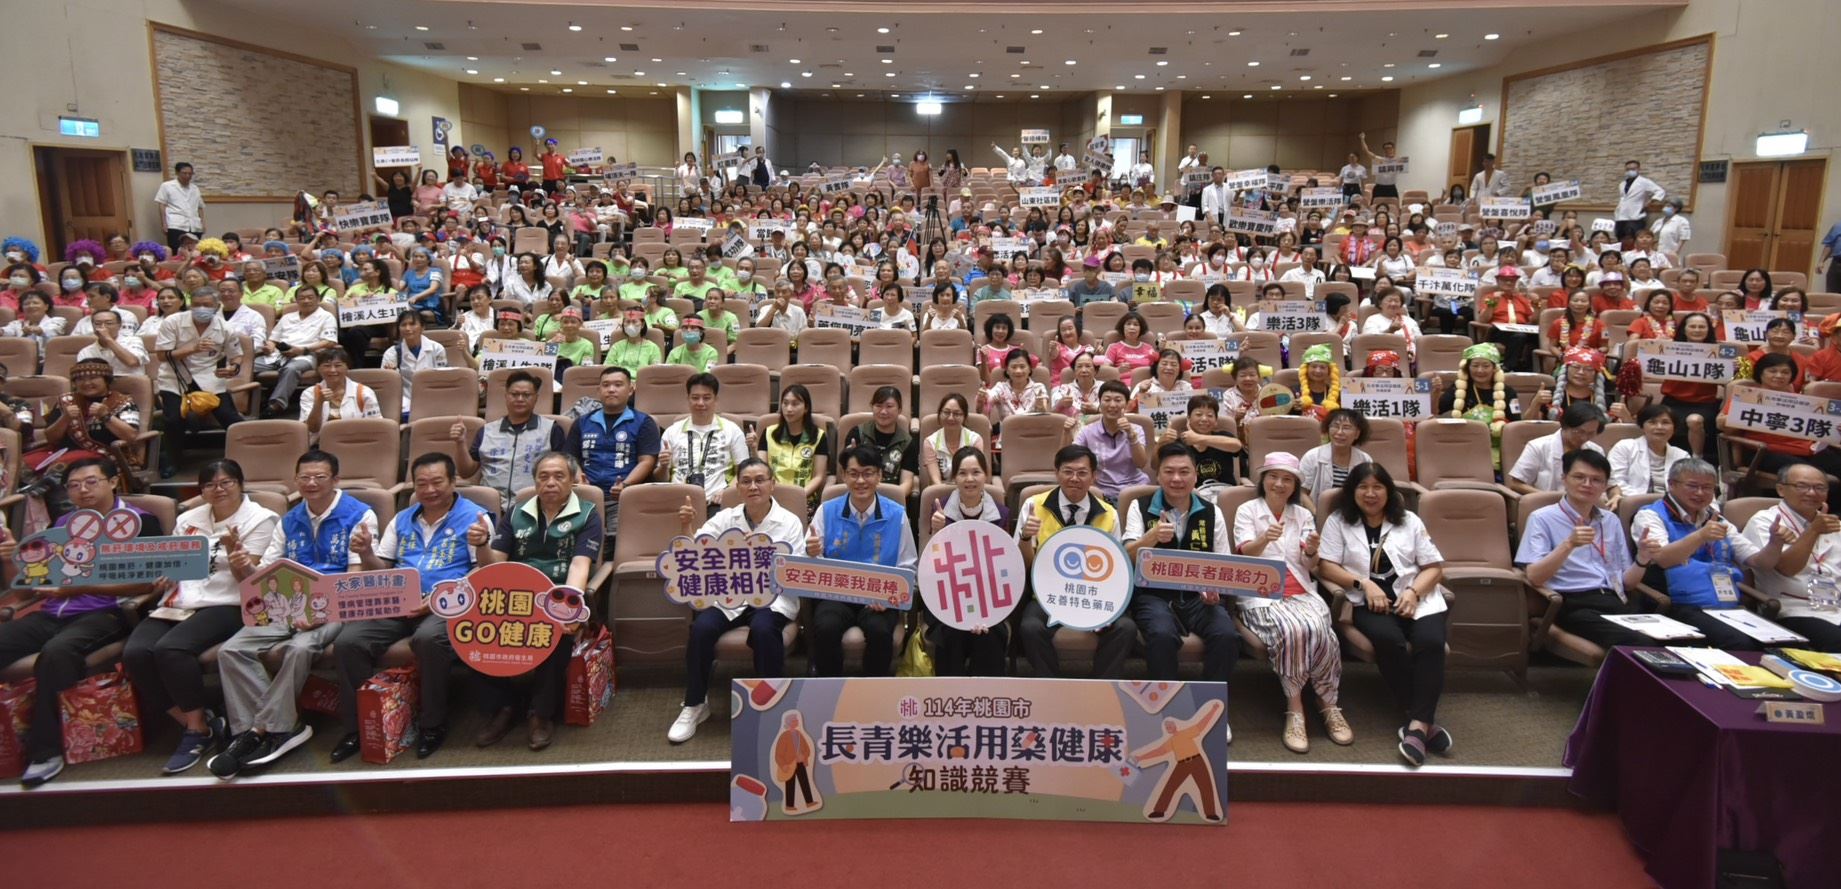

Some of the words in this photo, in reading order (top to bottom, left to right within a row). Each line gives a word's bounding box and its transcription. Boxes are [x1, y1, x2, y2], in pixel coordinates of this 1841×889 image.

[1266, 316, 1321, 331] 樂活3隊
[1646, 357, 1726, 380] 龜山1隊
[1415, 381, 1429, 391] 5-1
[1353, 399, 1421, 418] 樂活1隊
[1740, 408, 1833, 438] 中寧3隊
[674, 546, 777, 572] 安全用藥
[785, 568, 898, 595] 安全用藥我最棒
[1152, 561, 1268, 585] 桃園長者最給力
[1064, 582, 1098, 596] 桃園市
[479, 588, 534, 616] 桃園
[1047, 594, 1115, 612] 友善特色藥局
[454, 620, 553, 648] GO健康
[924, 697, 1032, 719] 114年桃園市
[821, 724, 1124, 763] 長青樂活用藥健康
[909, 764, 1031, 795] 知識競賽
